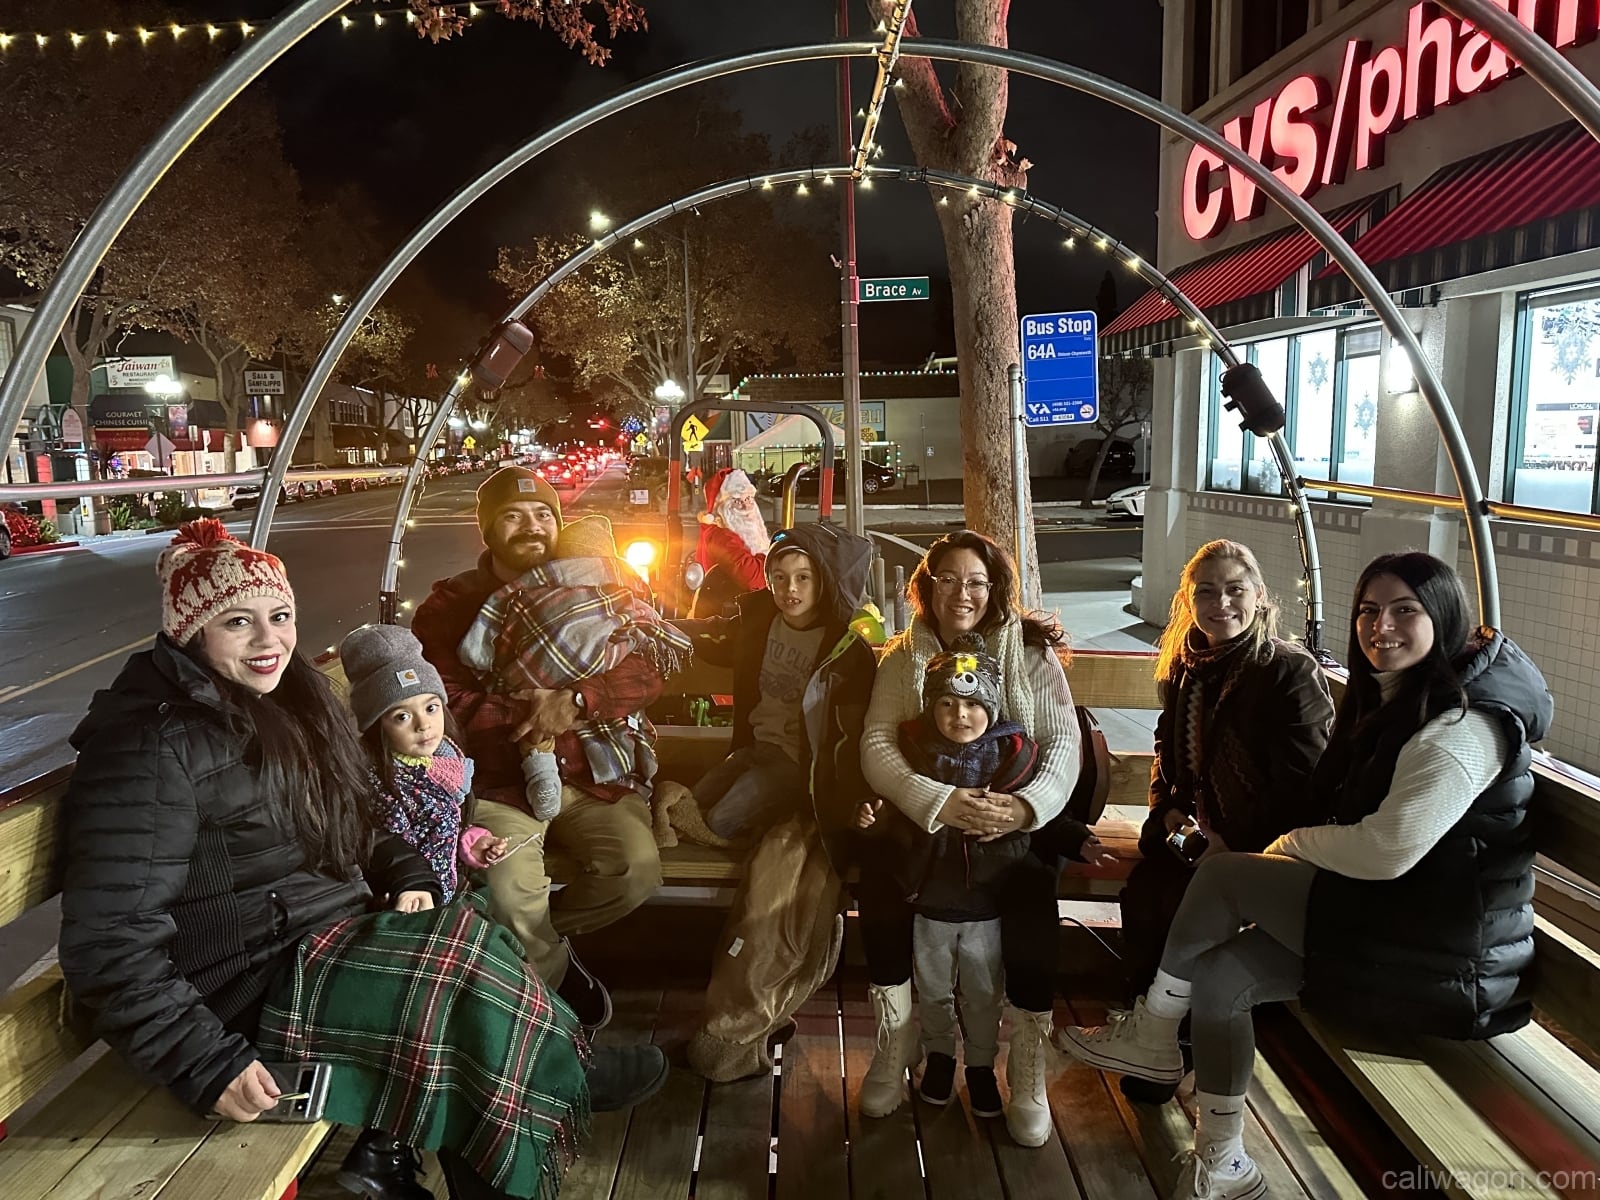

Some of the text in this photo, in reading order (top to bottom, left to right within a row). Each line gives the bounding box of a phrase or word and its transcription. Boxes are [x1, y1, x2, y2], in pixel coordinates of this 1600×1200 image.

[866, 284, 922, 296] Brace Av
[1026, 318, 1092, 336] Bus Stop
[1028, 344, 1056, 360] 64A
[117, 361, 158, 373] Taiwan
[860, 410, 881, 424] ELI
